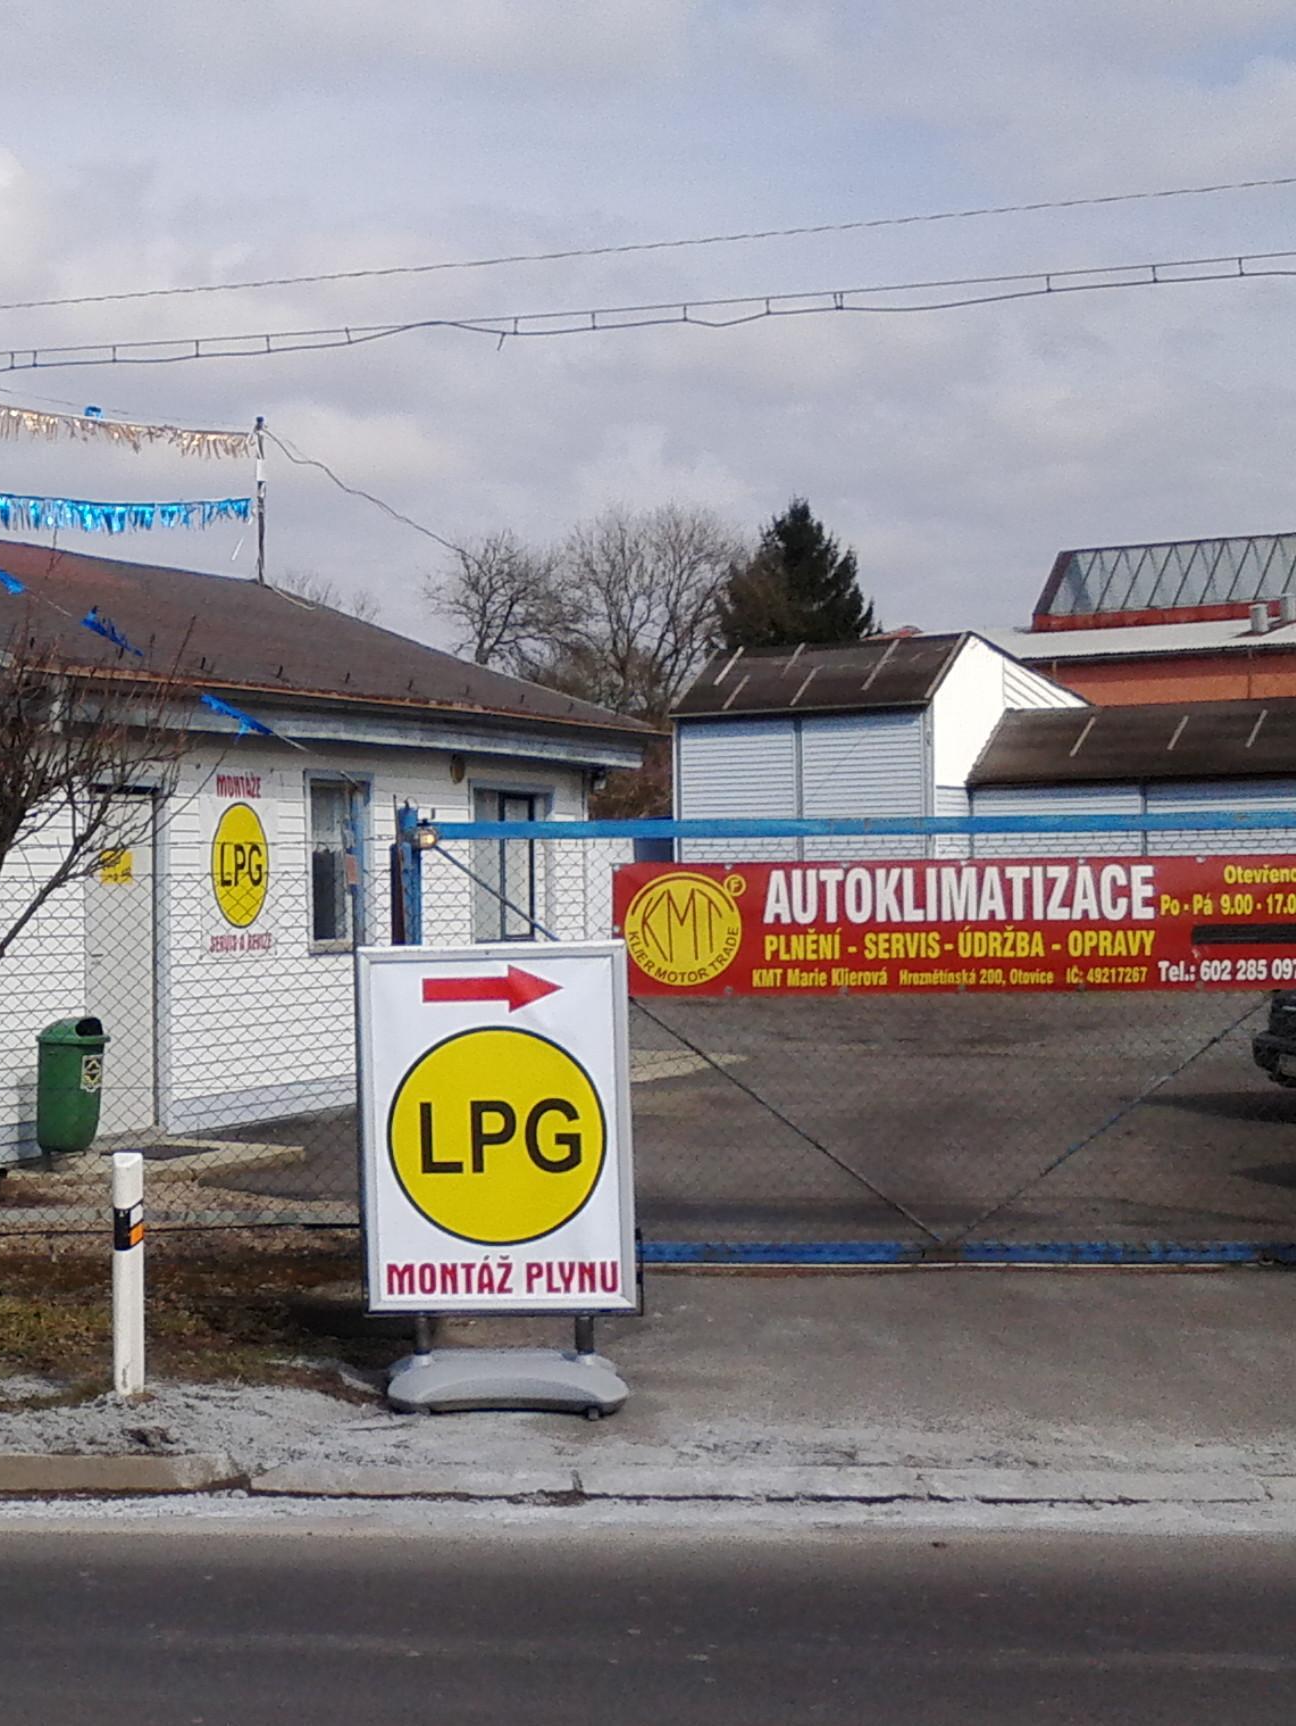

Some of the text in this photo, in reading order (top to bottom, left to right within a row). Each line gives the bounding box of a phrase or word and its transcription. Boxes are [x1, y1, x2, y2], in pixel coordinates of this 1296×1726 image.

[220, 842, 262, 888] LPG
[763, 863, 1155, 924] AUTOKLIMATIZACE
[1160, 894, 1180, 916] Po
[1193, 893, 1213, 915] Pá
[1220, 893, 1253, 915] 9.00
[641, 888, 722, 963] KMT
[765, 927, 842, 961] PLNĚNÍ
[864, 931, 941, 960] SERVIS
[958, 925, 1045, 958] ÚDRŽBA
[1067, 929, 1155, 958] OPRAVY
[628, 926, 739, 984] KLIER MOTOR TRADE
[1158, 959, 1196, 982] Tel.:
[1200, 959, 1232, 981] 602
[1236, 958, 1267, 981] 285
[752, 968, 783, 988] KMT
[787, 967, 827, 987] Marie
[832, 966, 887, 986] Klierová
[1009, 967, 1054, 985] Otovice
[1087, 966, 1147, 984] 49217267
[419, 1097, 582, 1174] LPG
[386, 1255, 619, 1295] MONTÁŽ PLYNU
